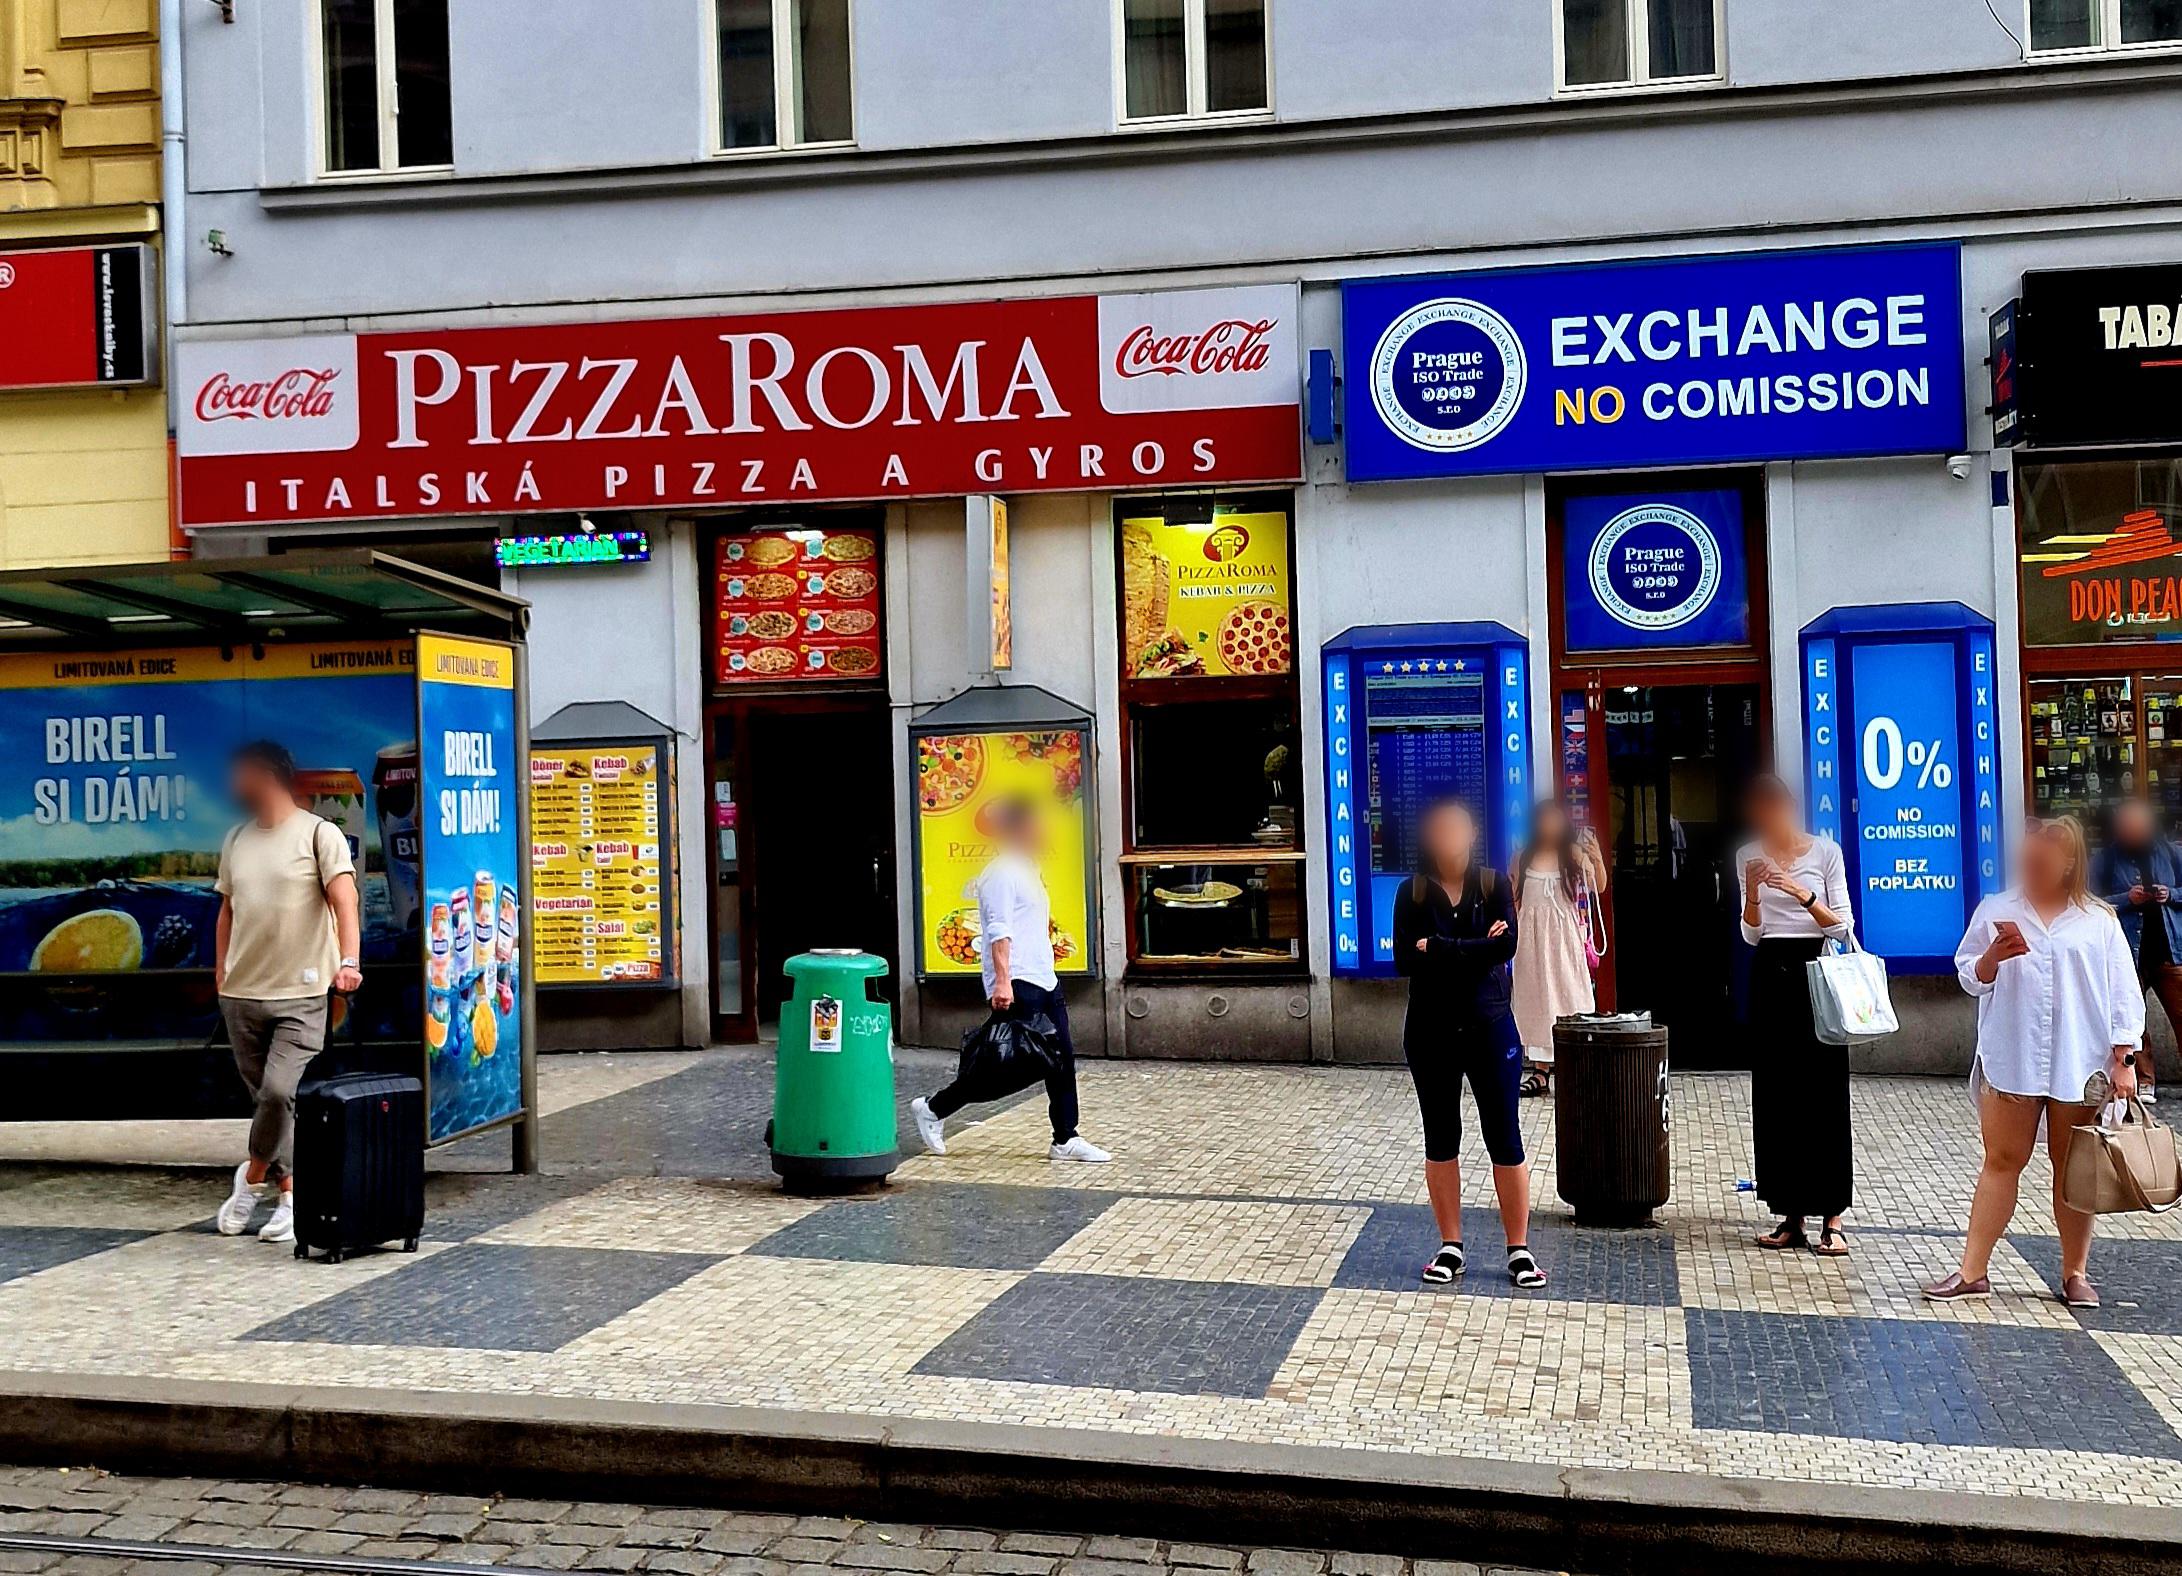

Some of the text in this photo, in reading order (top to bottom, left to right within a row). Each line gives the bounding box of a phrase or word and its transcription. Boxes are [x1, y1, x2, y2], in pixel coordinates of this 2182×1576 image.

[1551, 294, 1927, 367] EXCHANGE
[1114, 317, 1279, 380] Coca-Cola
[1382, 308, 1516, 434] EXCHANGE EXCHANGE EXCHANGE EXCHANGE EXCHANGE
[1412, 351, 1484, 370] Prague
[1413, 369, 1484, 384] ISO Trade
[194, 366, 342, 424] Coca-Cola
[384, 331, 1072, 450] PIZZAROMA
[1555, 367, 1929, 425] NO COMISSION
[244, 438, 1217, 513] ITALSKÁ PIZZA A GYROS
[502, 539, 619, 560] VEGETARIAN
[1624, 547, 1685, 562] Prague
[1598, 511, 1713, 616] EXCHANGE EXCHANGE EXCHANGE EXCHANGE EXCHANGE
[1625, 561, 1685, 574] ISO Trade
[1180, 583, 1276, 597] KEBAB & PIZZA
[2071, 577, 2122, 621] DON
[54, 657, 177, 680] LIMITOVANÁ EDICE
[310, 648, 394, 670] LIMITOVANÁ
[46, 714, 177, 764] BIRELL
[444, 730, 498, 777] BIRELL
[594, 758, 627, 769] Kebab
[1863, 716, 1952, 790] 0%
[1975, 653, 1995, 897] EXCHANG
[34, 765, 187, 825] SI DÁM!
[1333, 672, 1353, 919] EXCHANGE
[441, 789, 458, 836] SI
[460, 780, 501, 835] DÁM!
[1896, 807, 1922, 822] NO
[1863, 824, 1956, 840] COMISSION
[533, 845, 567, 856] Kebab
[596, 843, 629, 854] Kebab
[1895, 859, 1928, 873] BEZ
[1868, 875, 1956, 890] POPLATKU
[535, 899, 593, 910] Vegetarian
[1338, 934, 1358, 953] 0%
